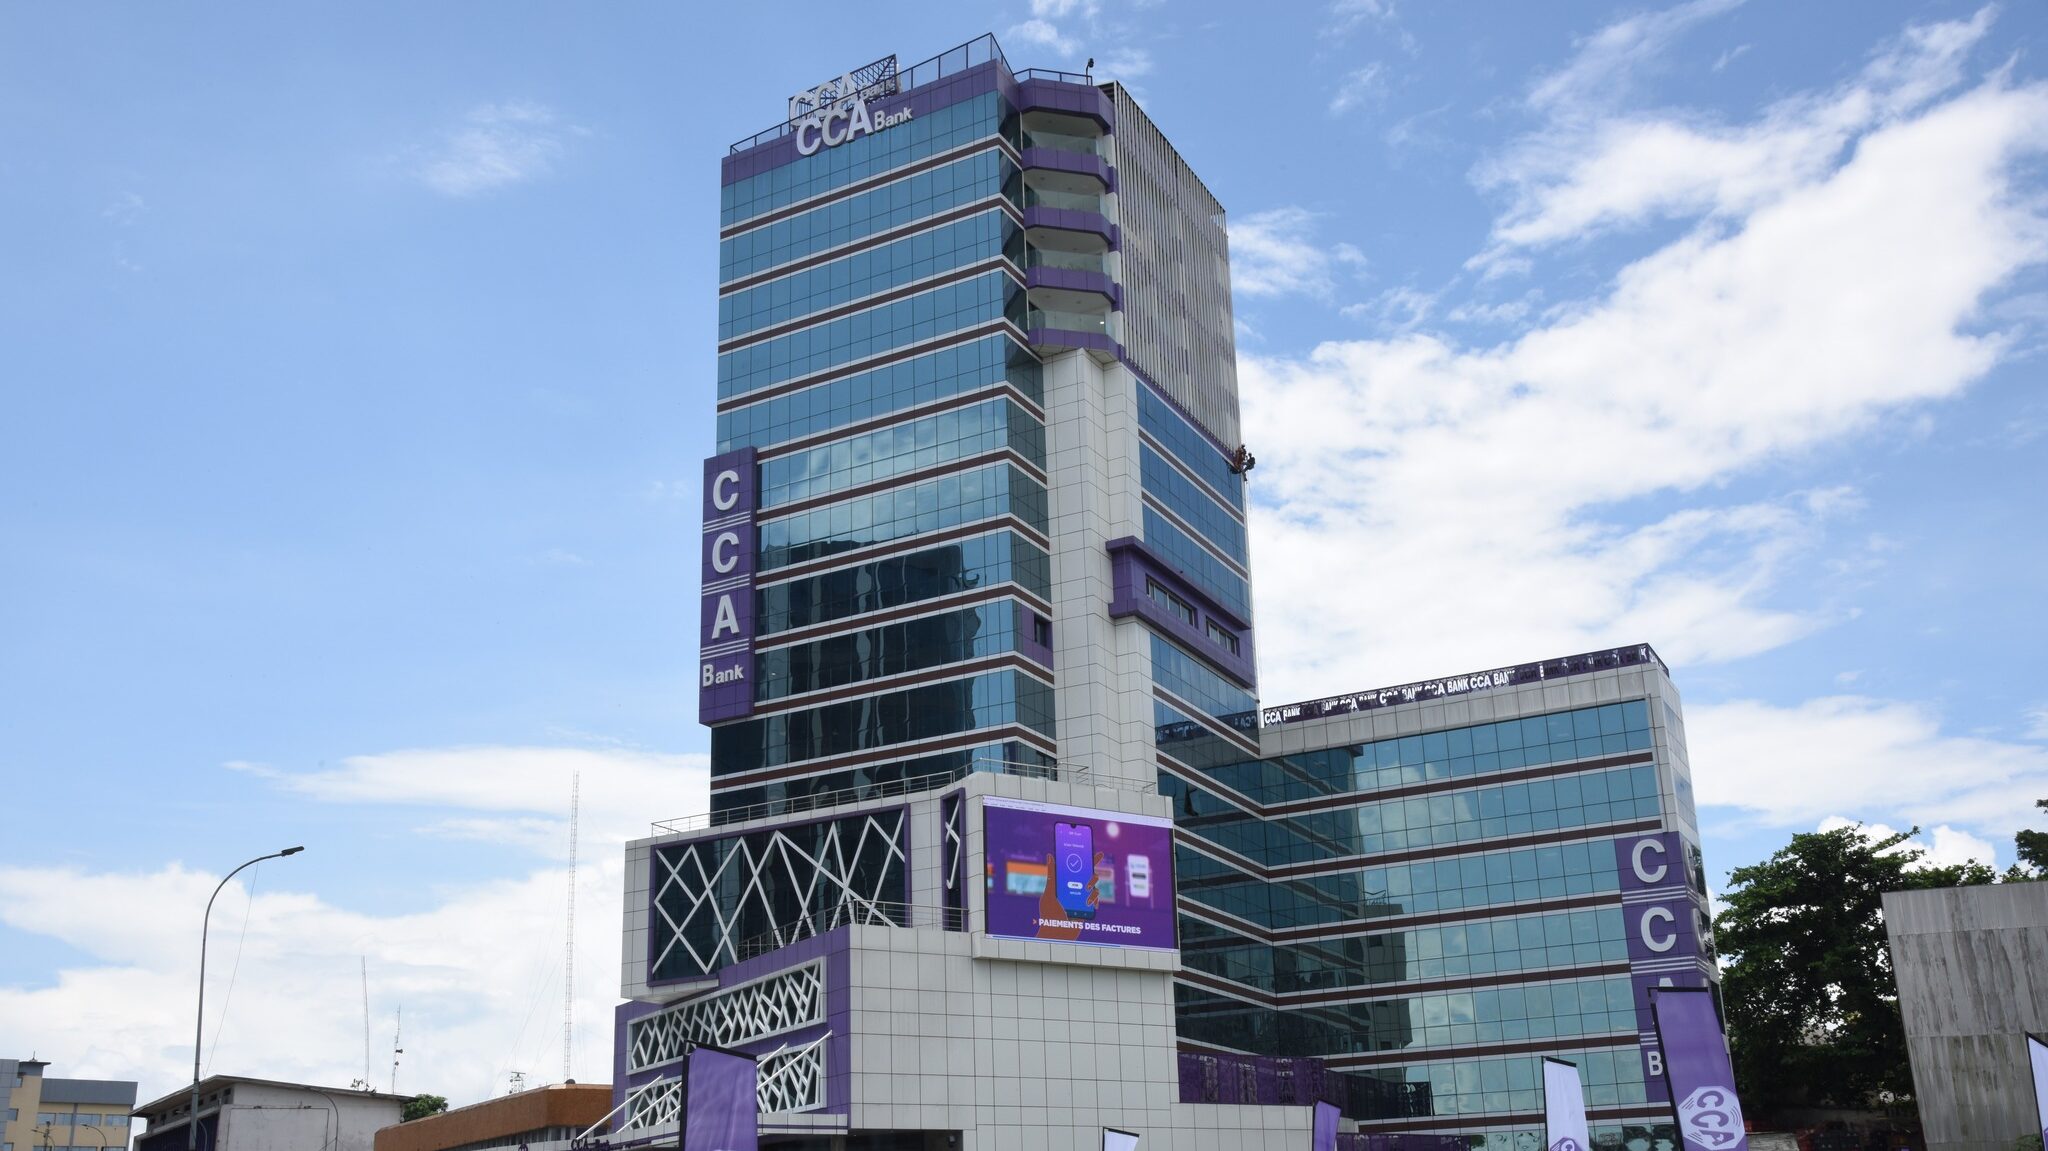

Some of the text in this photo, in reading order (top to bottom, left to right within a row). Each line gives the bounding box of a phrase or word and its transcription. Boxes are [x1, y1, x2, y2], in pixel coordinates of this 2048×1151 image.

[796, 98, 913, 156] CCA Bank
[702, 663, 744, 688] Bank
[1264, 711, 1281, 724] CCA
[1447, 677, 1470, 693] BANK
[1470, 675, 1492, 690] CCA
[1038, 918, 1142, 934] PAIEMENTS DES FACTURES
[1690, 1090, 1735, 1147] CCA
